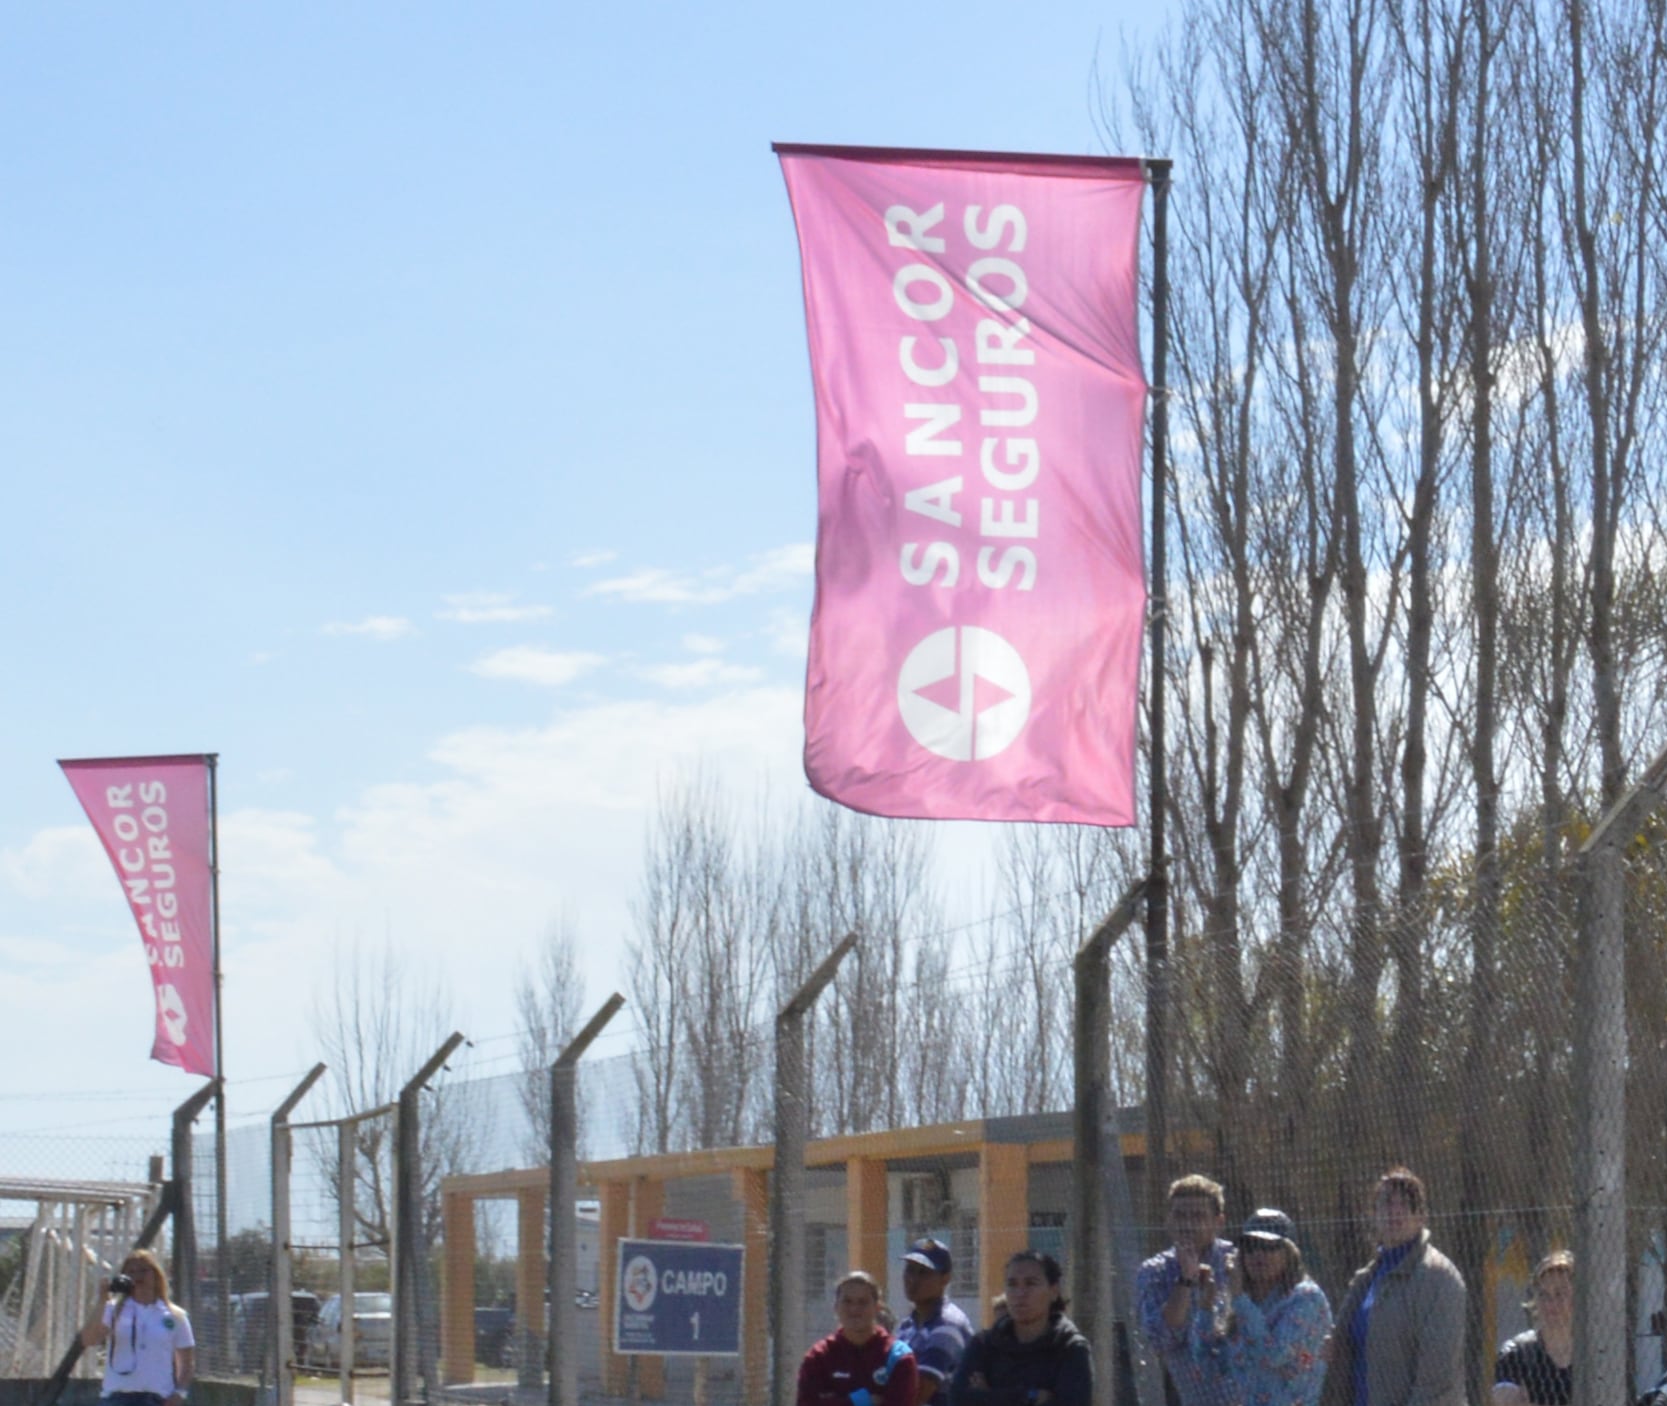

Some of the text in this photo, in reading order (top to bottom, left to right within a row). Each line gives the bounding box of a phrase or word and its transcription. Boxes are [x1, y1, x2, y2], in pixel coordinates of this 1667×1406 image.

[885, 202, 963, 589] SANCOR
[963, 203, 1040, 592] SEGUROS
[139, 780, 185, 968] SEGUROS
[661, 1268, 728, 1297] CAMPO
[689, 1311, 701, 1341] 1
